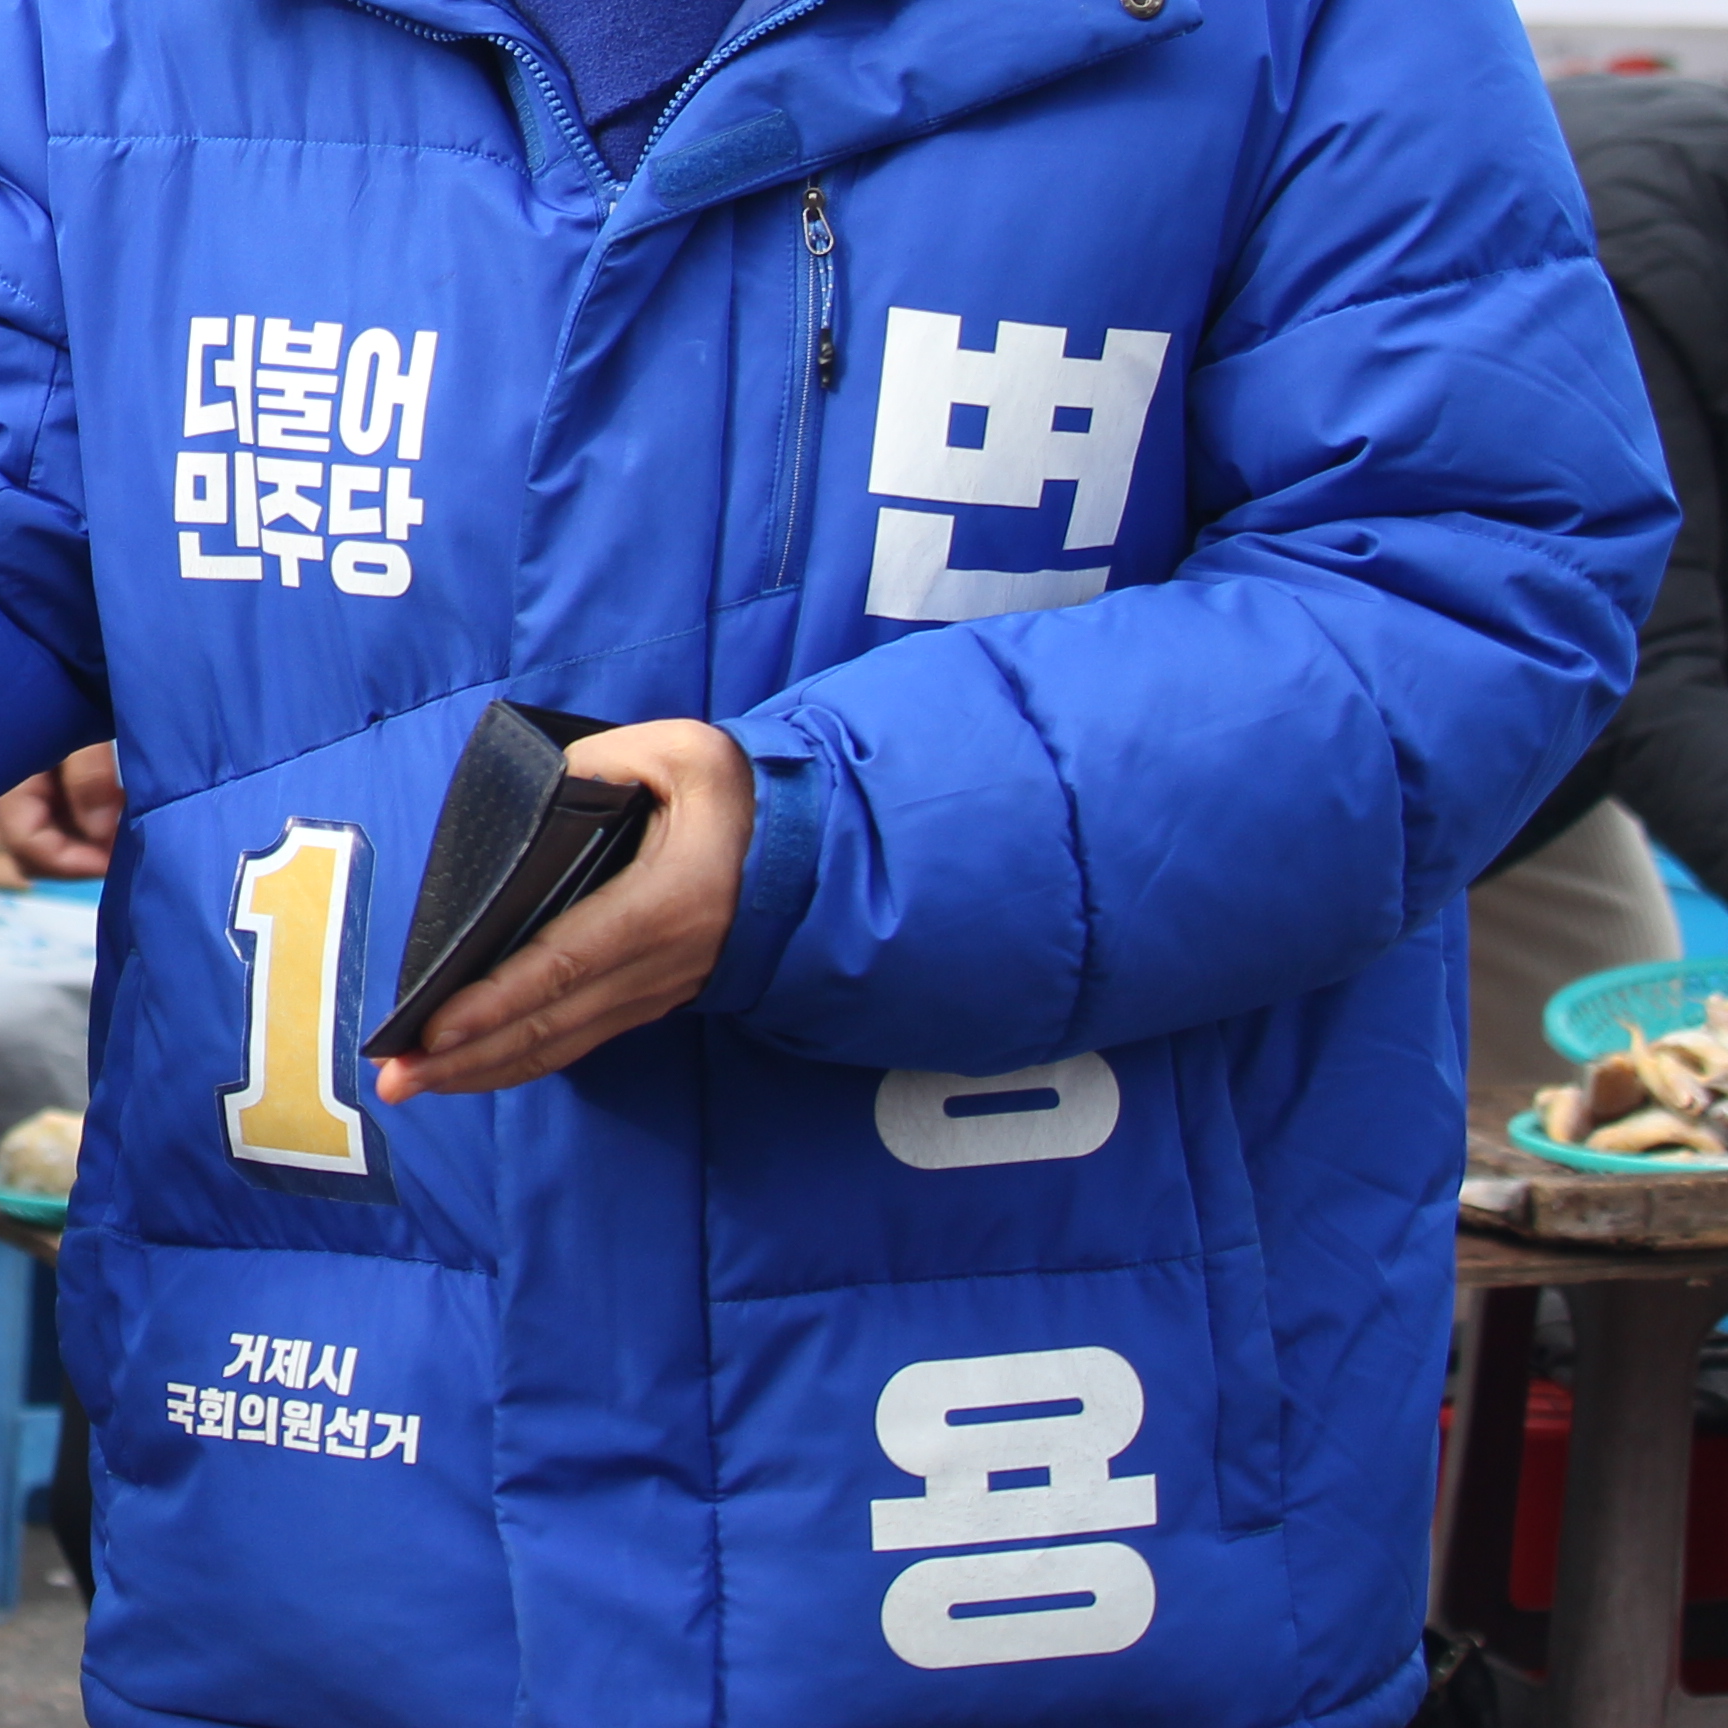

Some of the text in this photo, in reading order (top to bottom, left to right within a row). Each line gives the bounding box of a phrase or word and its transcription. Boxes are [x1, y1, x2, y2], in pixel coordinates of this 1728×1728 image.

[184, 314, 439, 461] 더불어
[174, 451, 425, 598] 민주당
[220, 822, 382, 1187] 1
[166, 1382, 422, 1465] 국회의원선거
[222, 1332, 359, 1397] 거제시
